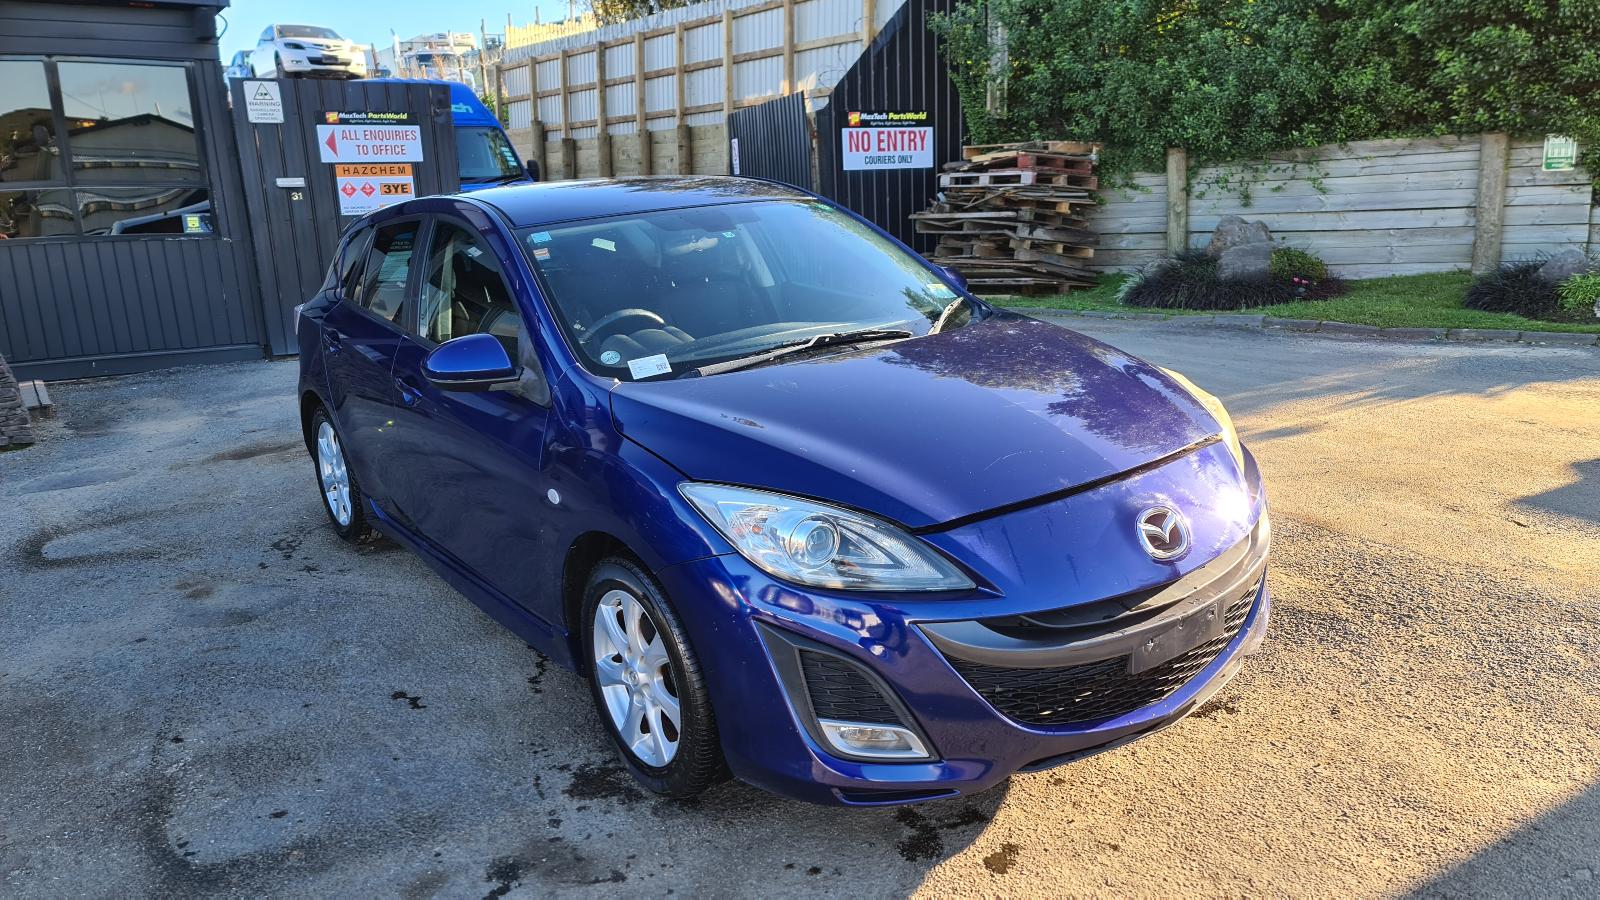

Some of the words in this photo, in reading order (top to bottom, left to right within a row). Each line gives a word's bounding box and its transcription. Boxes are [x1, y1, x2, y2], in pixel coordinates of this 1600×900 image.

[888, 112, 927, 120] PartsWorld
[341, 130, 360, 141] ALL
[364, 130, 417, 141] ENQUIRIES
[848, 131, 871, 152] NO
[877, 130, 927, 152] ENTRY
[356, 144, 369, 155] TO
[372, 144, 407, 155] OFFICE
[864, 155, 896, 165] COURIERS
[898, 155, 913, 164] ONLY
[343, 166, 406, 175] HAZCHEM
[383, 184, 409, 193] 3YE
[291, 192, 304, 200] 31
